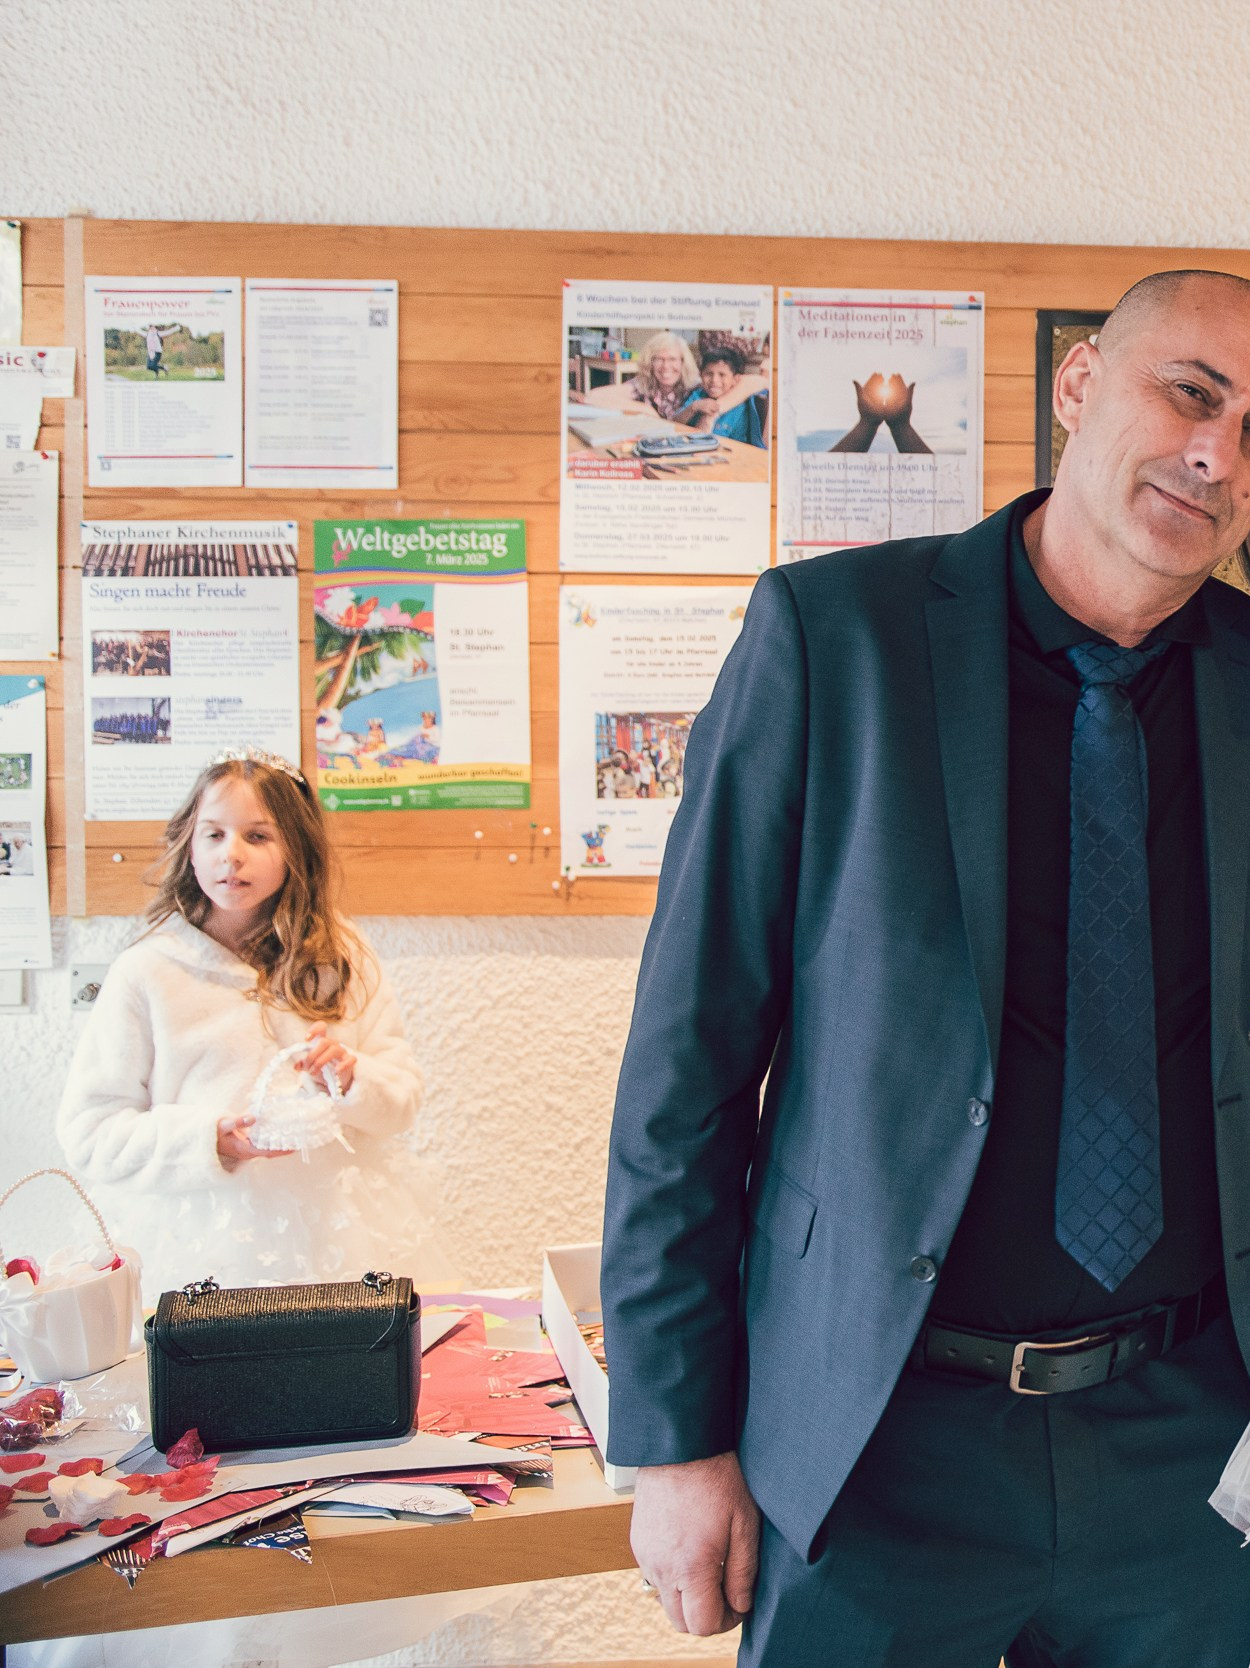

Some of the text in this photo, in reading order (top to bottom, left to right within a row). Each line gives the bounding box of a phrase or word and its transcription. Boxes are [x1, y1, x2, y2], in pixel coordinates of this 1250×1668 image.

[103, 297, 190, 313] Frauenpower
[586, 294, 628, 303] Wochen
[630, 296, 647, 304] bei
[650, 296, 666, 304] der
[670, 296, 712, 308] Stiftung
[798, 309, 906, 323] Meditationen in
[797, 327, 924, 341] der Fastenzeit 2025
[92, 526, 286, 543] Stephaner Kirchenmusik
[333, 526, 508, 559] Weltgebetstag
[426, 552, 489, 566] 7. März 2025
[89, 582, 247, 603] Singen macht Freude
[176, 629, 237, 638] Kirchenchor
[477, 627, 494, 636] Uhr
[464, 643, 505, 652] Stephan
[323, 772, 398, 786] Cookinseln
